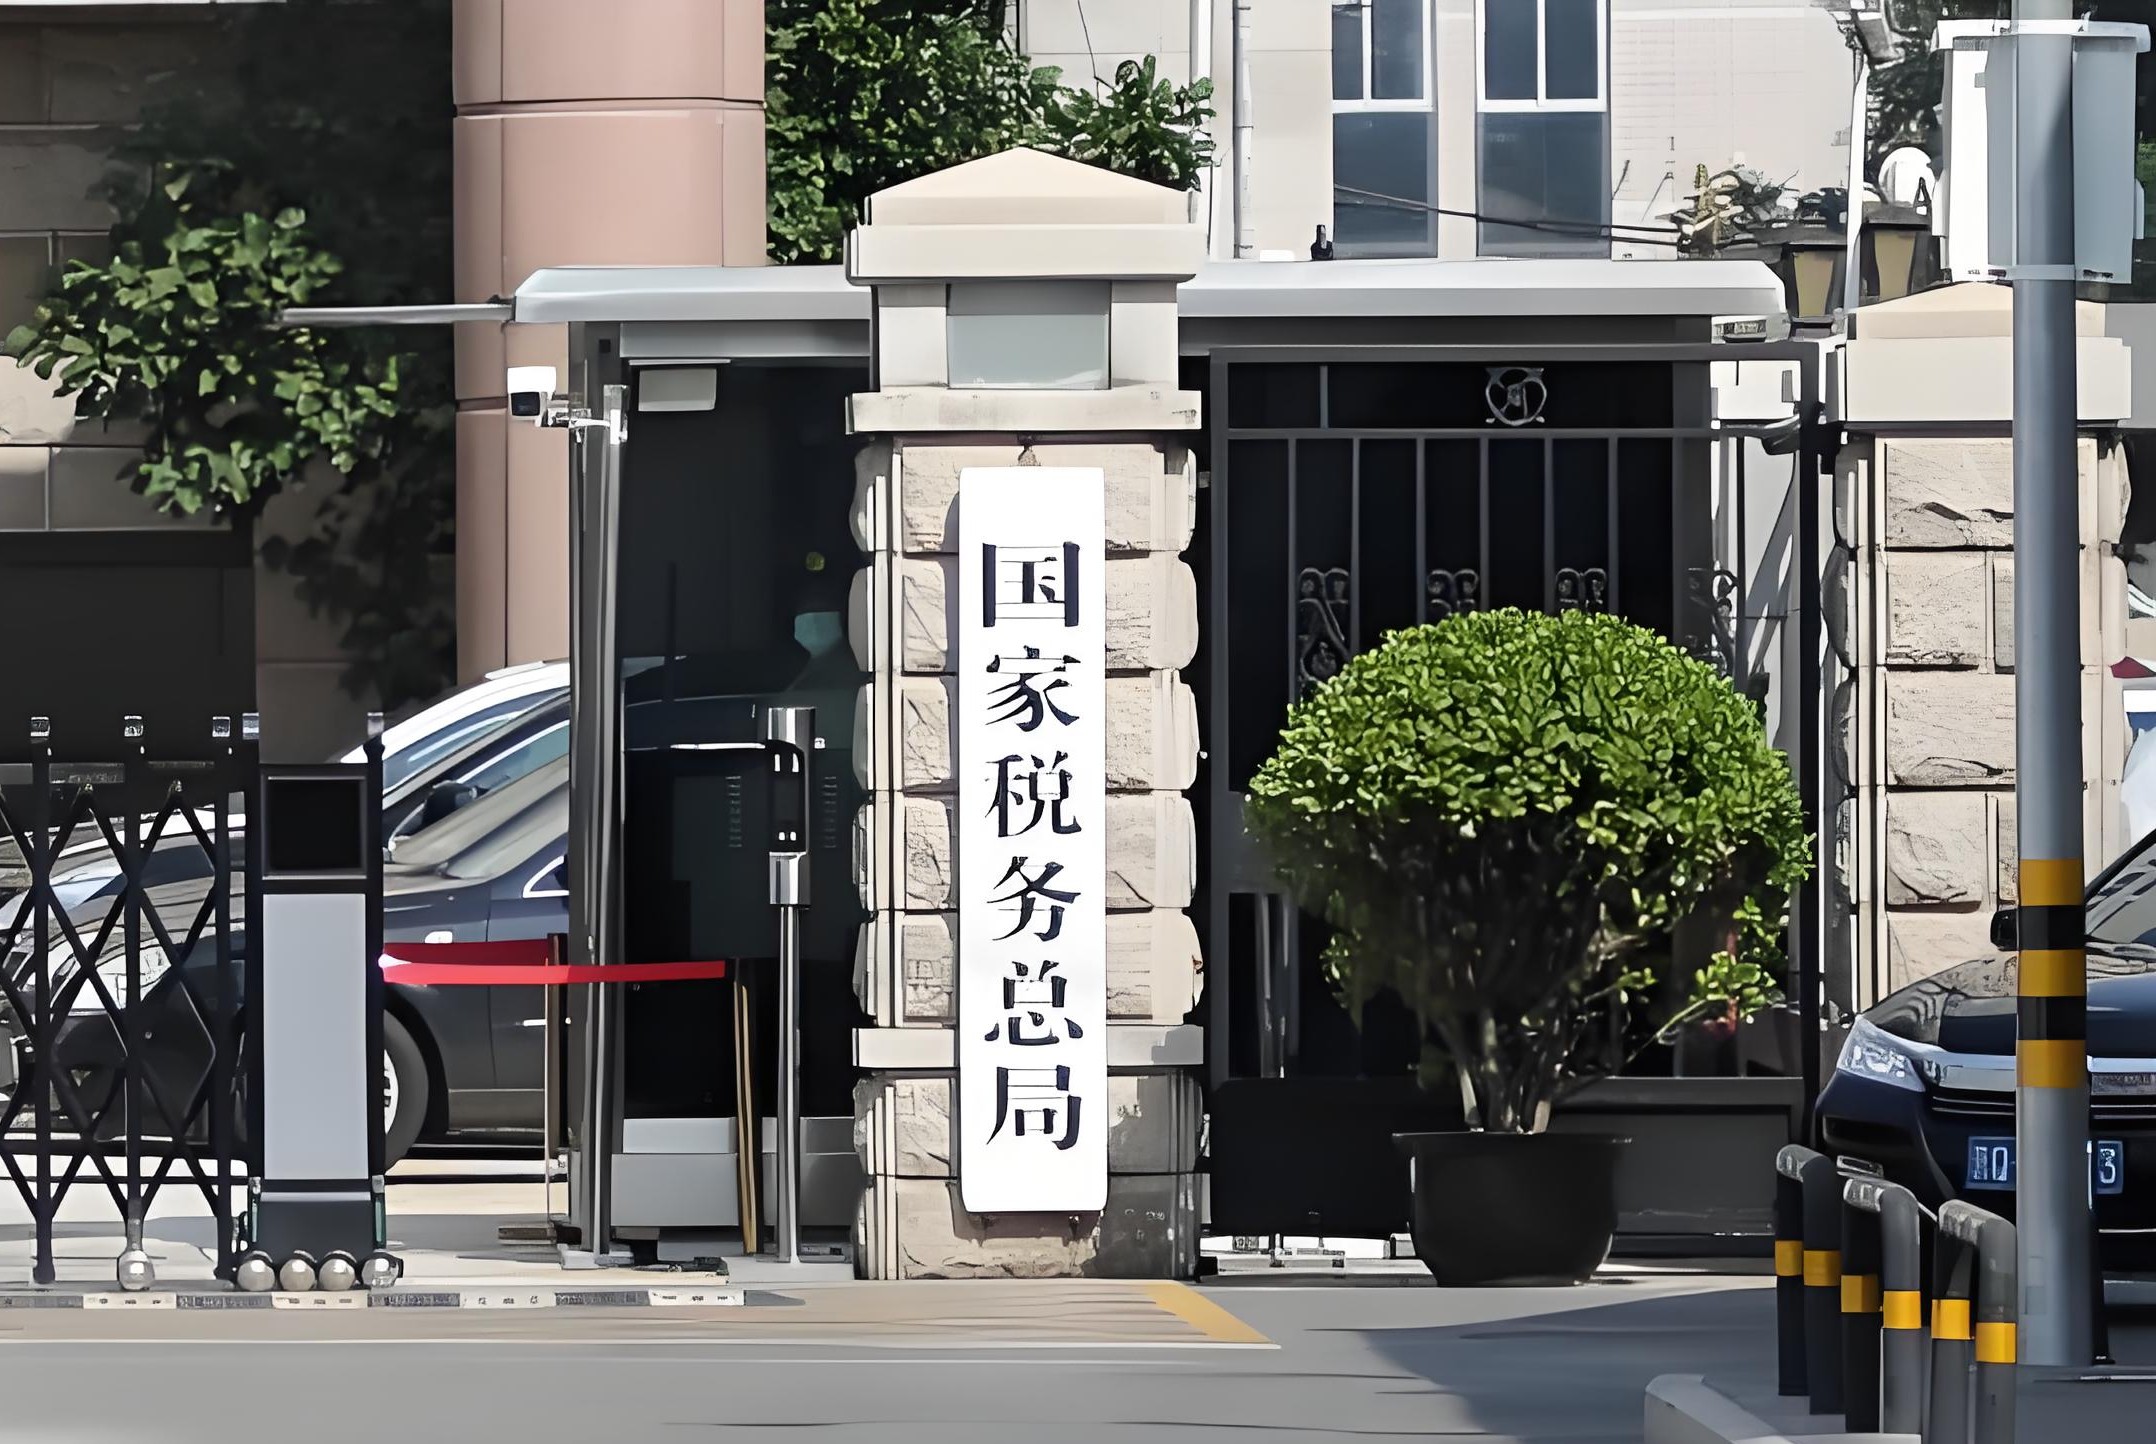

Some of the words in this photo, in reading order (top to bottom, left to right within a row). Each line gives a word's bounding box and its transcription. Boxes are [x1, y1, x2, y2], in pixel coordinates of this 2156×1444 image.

[982, 541, 1084, 1150] 国家税务总局
